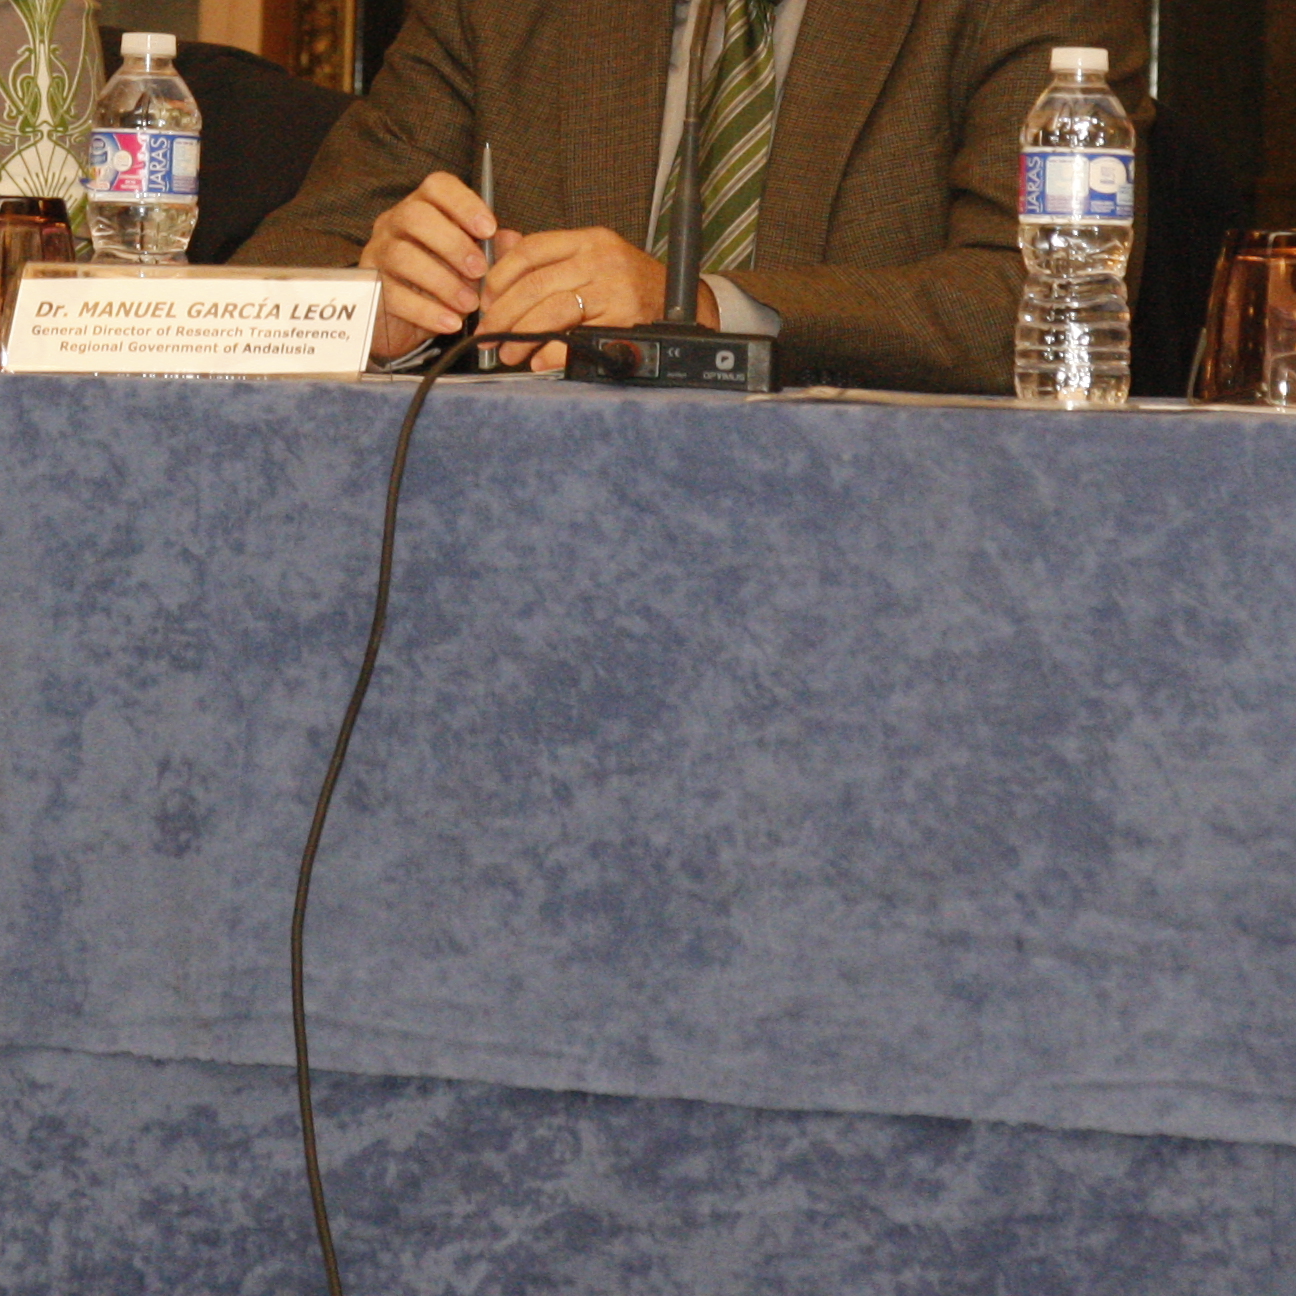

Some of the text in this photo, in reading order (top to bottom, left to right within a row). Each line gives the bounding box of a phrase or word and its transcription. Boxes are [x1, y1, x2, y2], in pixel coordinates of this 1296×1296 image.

[149, 137, 168, 192] JARAS
[1027, 156, 1042, 213] JARAS
[34, 296, 357, 321] Dr. MANUEL GARCÍA LEÓN
[31, 324, 352, 342] General Director of Research Transference,
[59, 341, 316, 356] Regional Government of Andalusia
